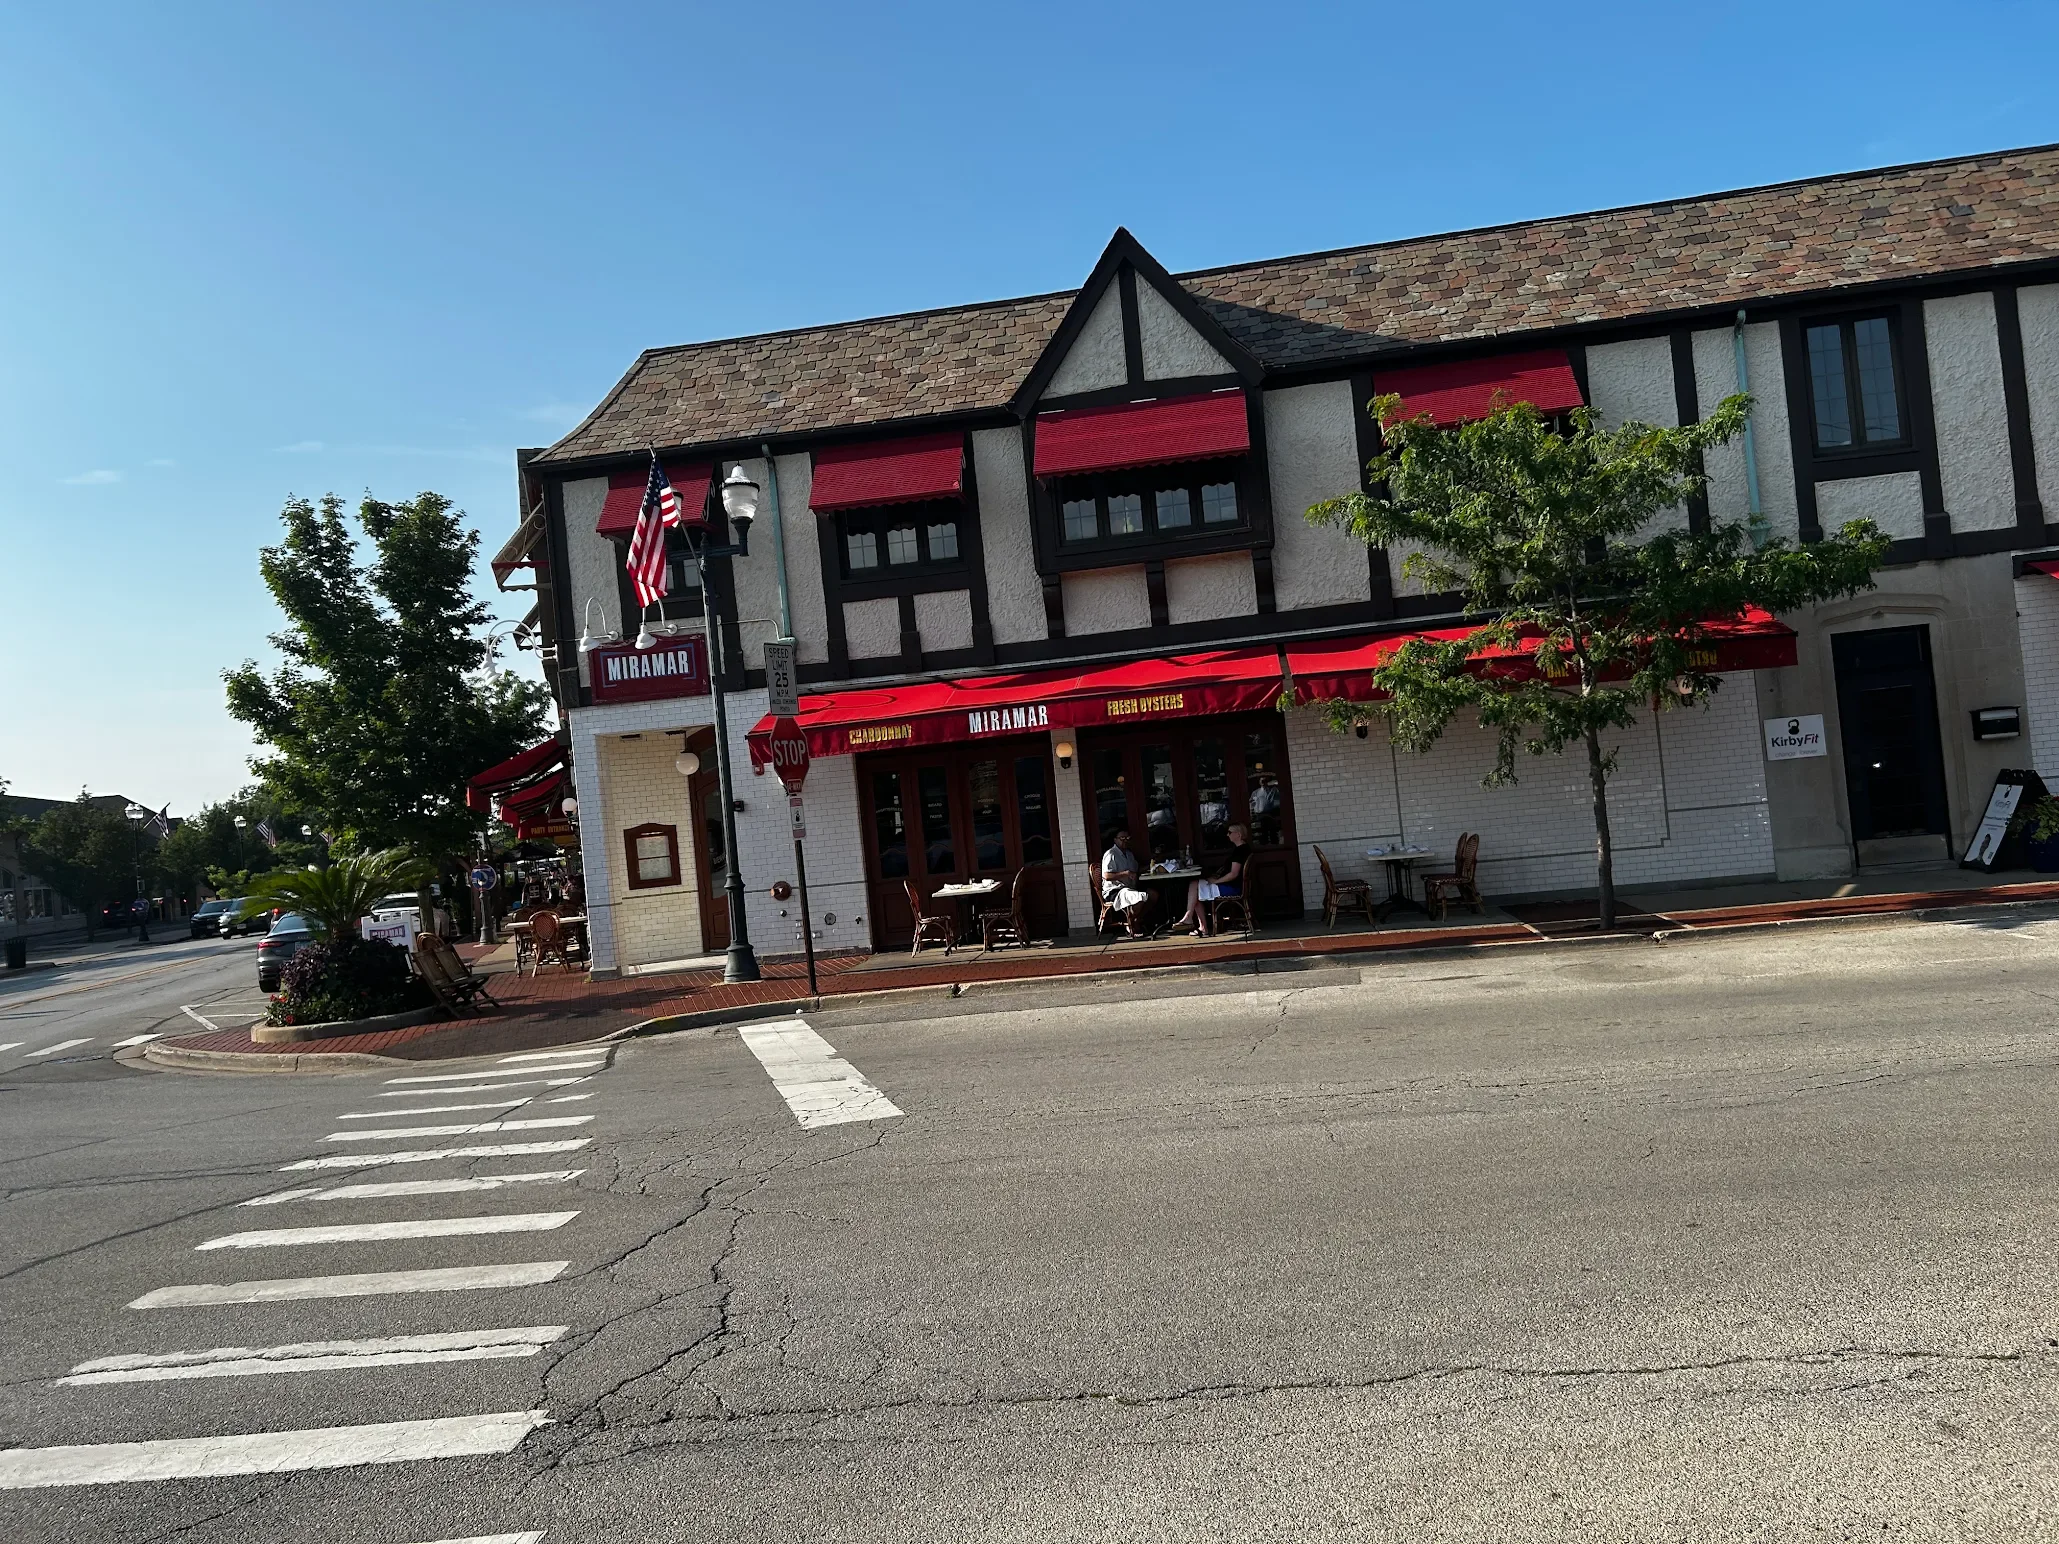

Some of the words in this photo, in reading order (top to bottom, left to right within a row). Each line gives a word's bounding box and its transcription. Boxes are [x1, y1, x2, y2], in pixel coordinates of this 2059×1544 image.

[769, 648, 789, 659] SPEED
[607, 650, 689, 681] MIRAMAR
[773, 660, 788, 671] LIMIT
[775, 672, 789, 688] 25
[1106, 698, 1138, 716] FRESH
[1139, 693, 1184, 713] OYSTERS
[968, 704, 1049, 734] MIRAMAR
[848, 723, 912, 745] CHARDONNAY
[1770, 733, 1819, 748] KirbyFit
[773, 739, 806, 767] STOP
